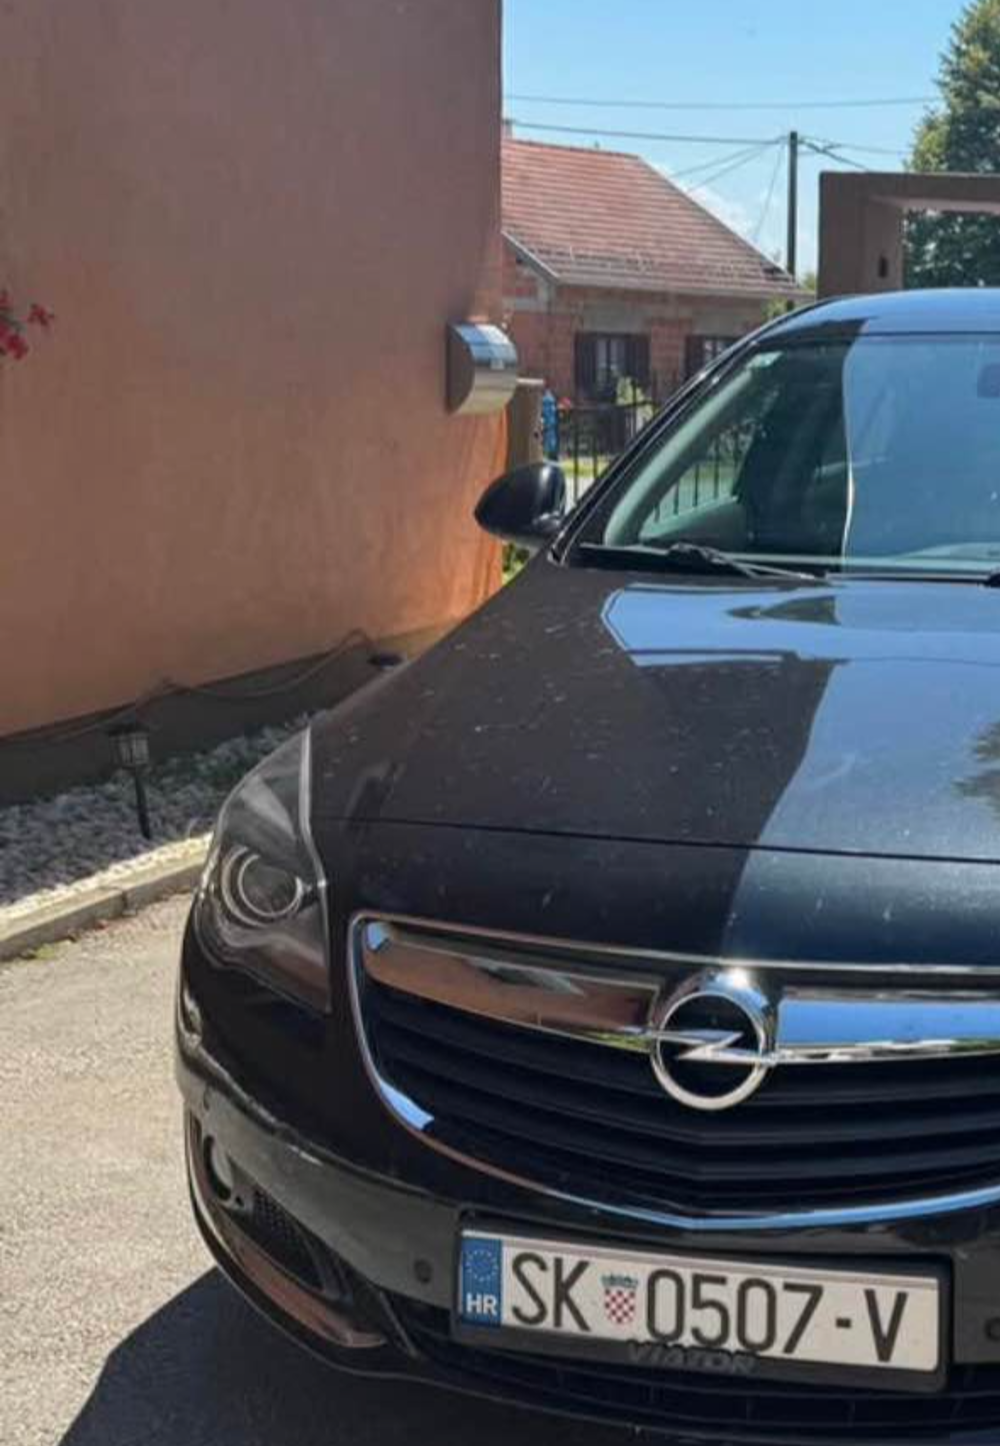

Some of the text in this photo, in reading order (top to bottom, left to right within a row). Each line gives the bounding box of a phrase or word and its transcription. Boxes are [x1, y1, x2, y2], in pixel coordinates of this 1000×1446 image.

[466, 1292, 498, 1316] HR
[512, 1251, 909, 1363] SK 0507-V
[627, 1341, 757, 1374] VIATOR
